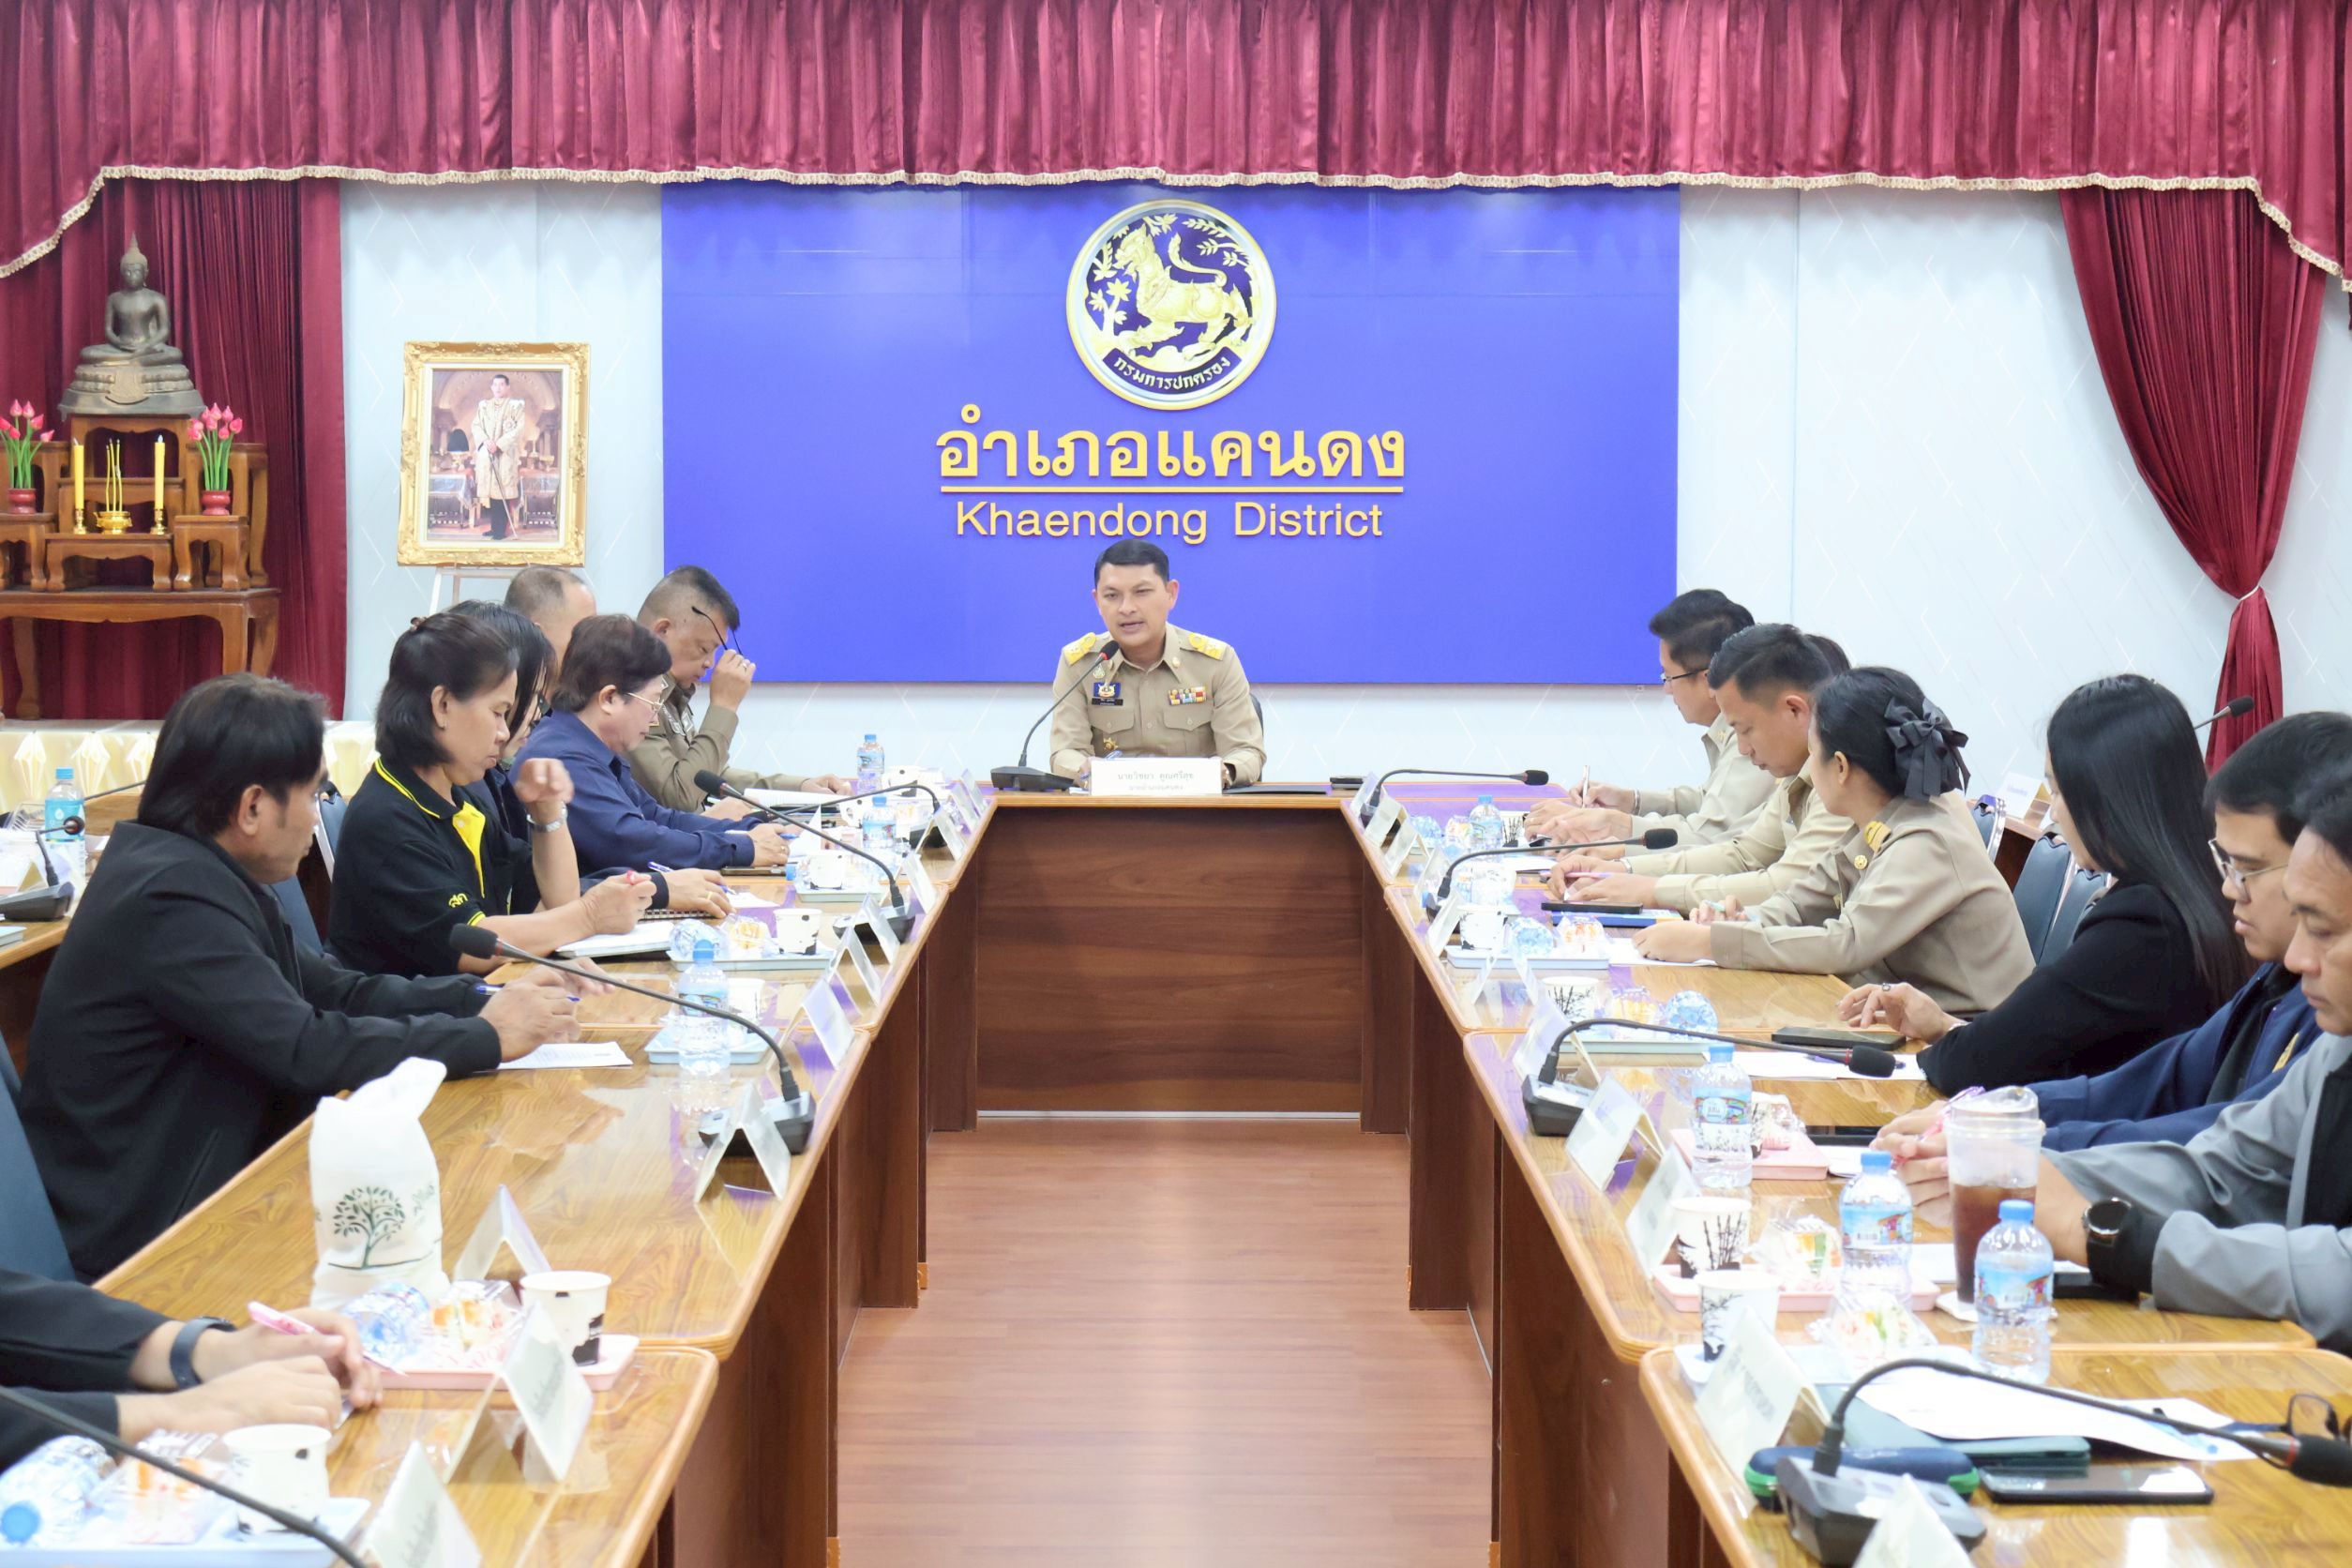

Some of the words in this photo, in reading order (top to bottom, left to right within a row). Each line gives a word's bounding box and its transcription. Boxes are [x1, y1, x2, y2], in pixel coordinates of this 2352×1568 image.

[1113, 356, 1231, 390] กรมการปกครอง
[936, 403, 1406, 478] อำเภอแคนดง
[956, 501, 1208, 545] Khaendong
[1234, 501, 1383, 537] District
